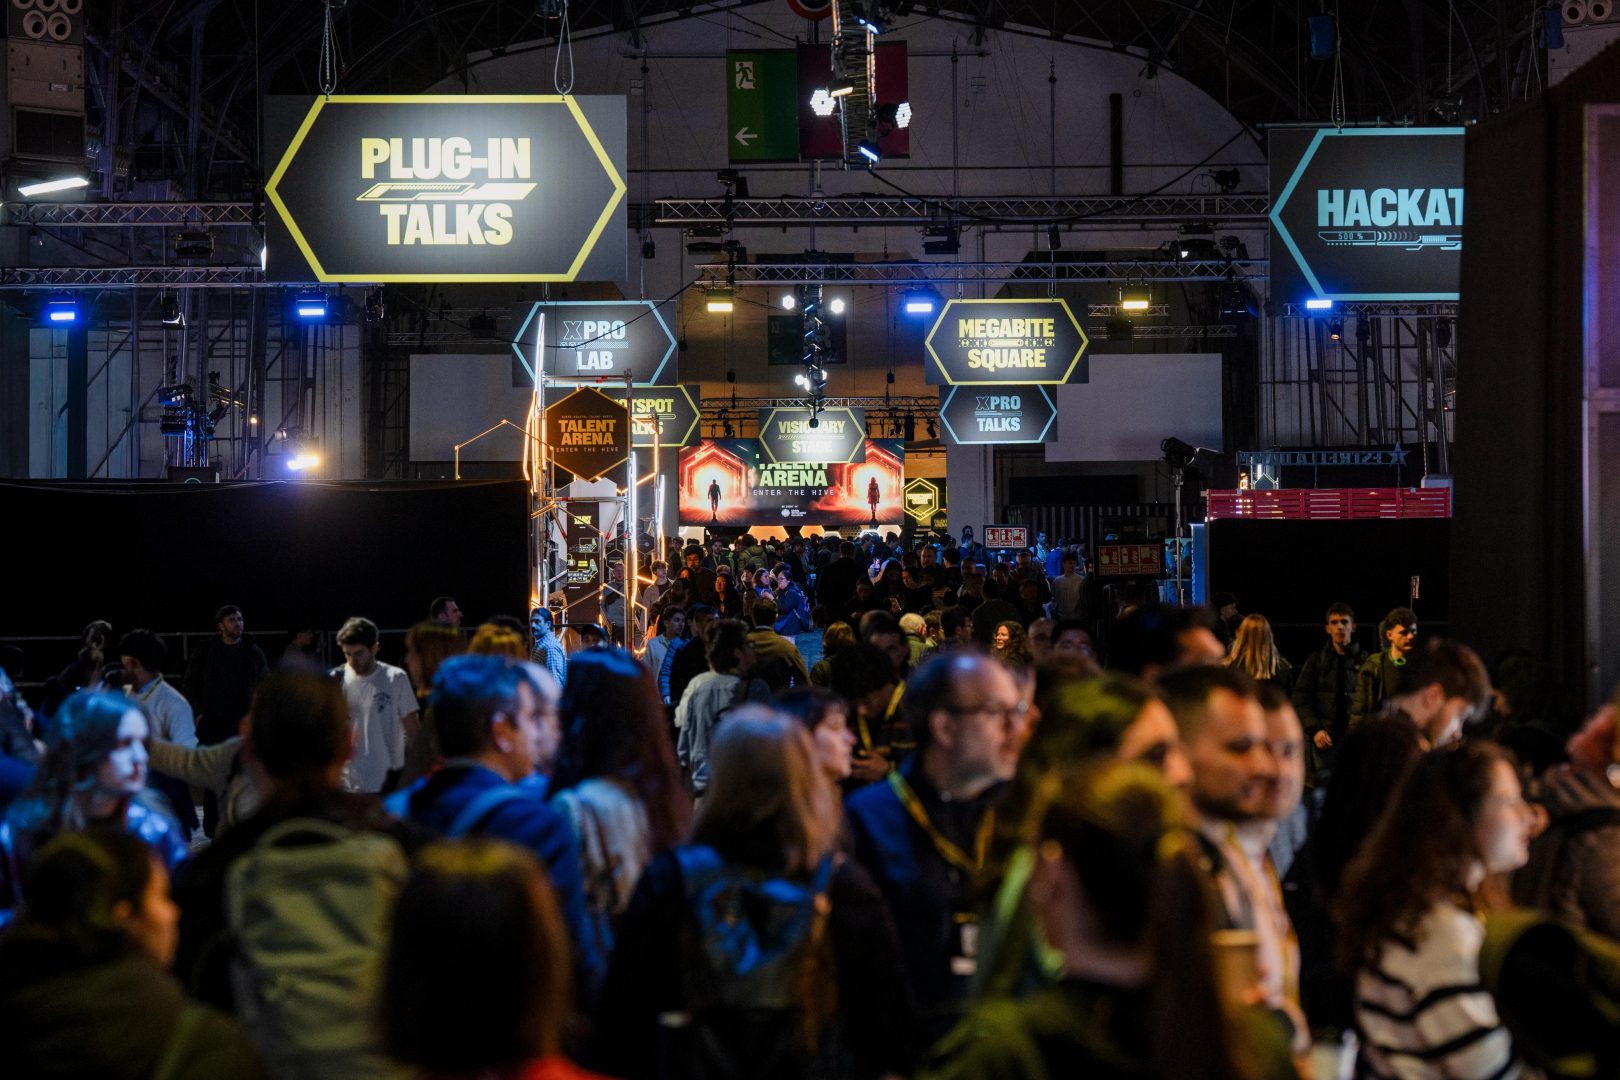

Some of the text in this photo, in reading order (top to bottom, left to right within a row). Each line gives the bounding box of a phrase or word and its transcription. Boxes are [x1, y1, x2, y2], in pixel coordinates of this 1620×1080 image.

[361, 136, 531, 180] PLUG-IN
[1317, 188, 1464, 227] HACKAT
[380, 203, 513, 246] TALKS
[958, 318, 1055, 338] MEGABITE
[576, 351, 614, 370] LAB
[967, 349, 1047, 372] SQUARE
[615, 398, 674, 413] OTSPOT
[558, 419, 617, 433] TALENT
[976, 417, 1021, 432] TALKS
[561, 433, 614, 446] ARENA
[791, 440, 833, 454] STAGE
[759, 470, 829, 487] ARENA
